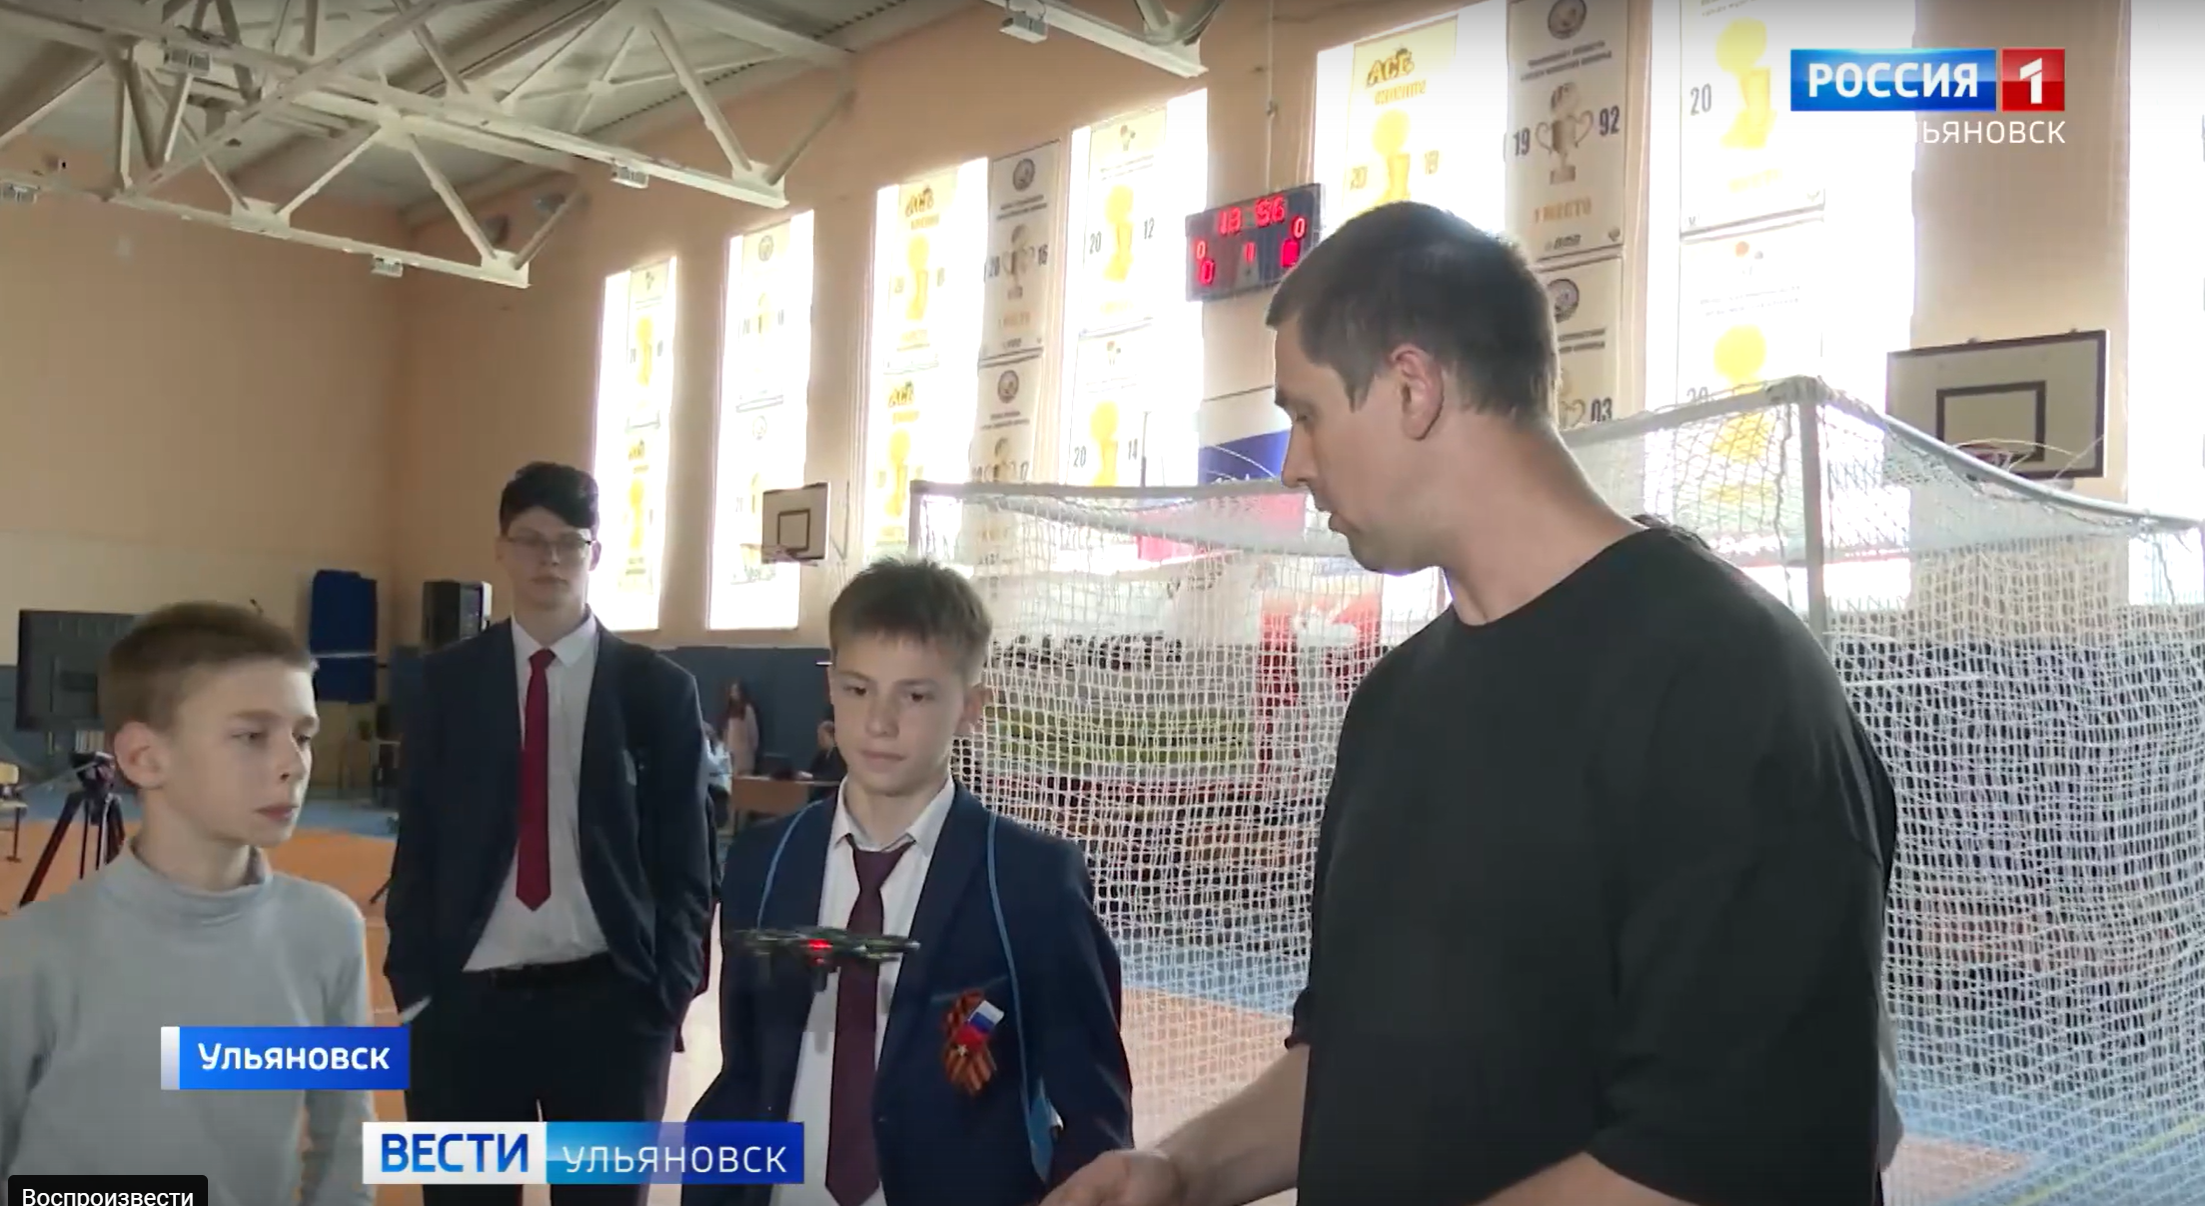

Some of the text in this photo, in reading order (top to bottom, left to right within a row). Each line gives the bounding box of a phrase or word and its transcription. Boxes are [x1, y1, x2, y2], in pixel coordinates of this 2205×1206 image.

[1690, 83, 1712, 116] 20
[1513, 105, 1621, 157] 19 92
[1089, 217, 1155, 255] 20 12
[1294, 217, 1306, 239] 0
[1196, 240, 1206, 260] 0
[1201, 260, 1215, 285] 0
[1073, 445, 1087, 468] 20
